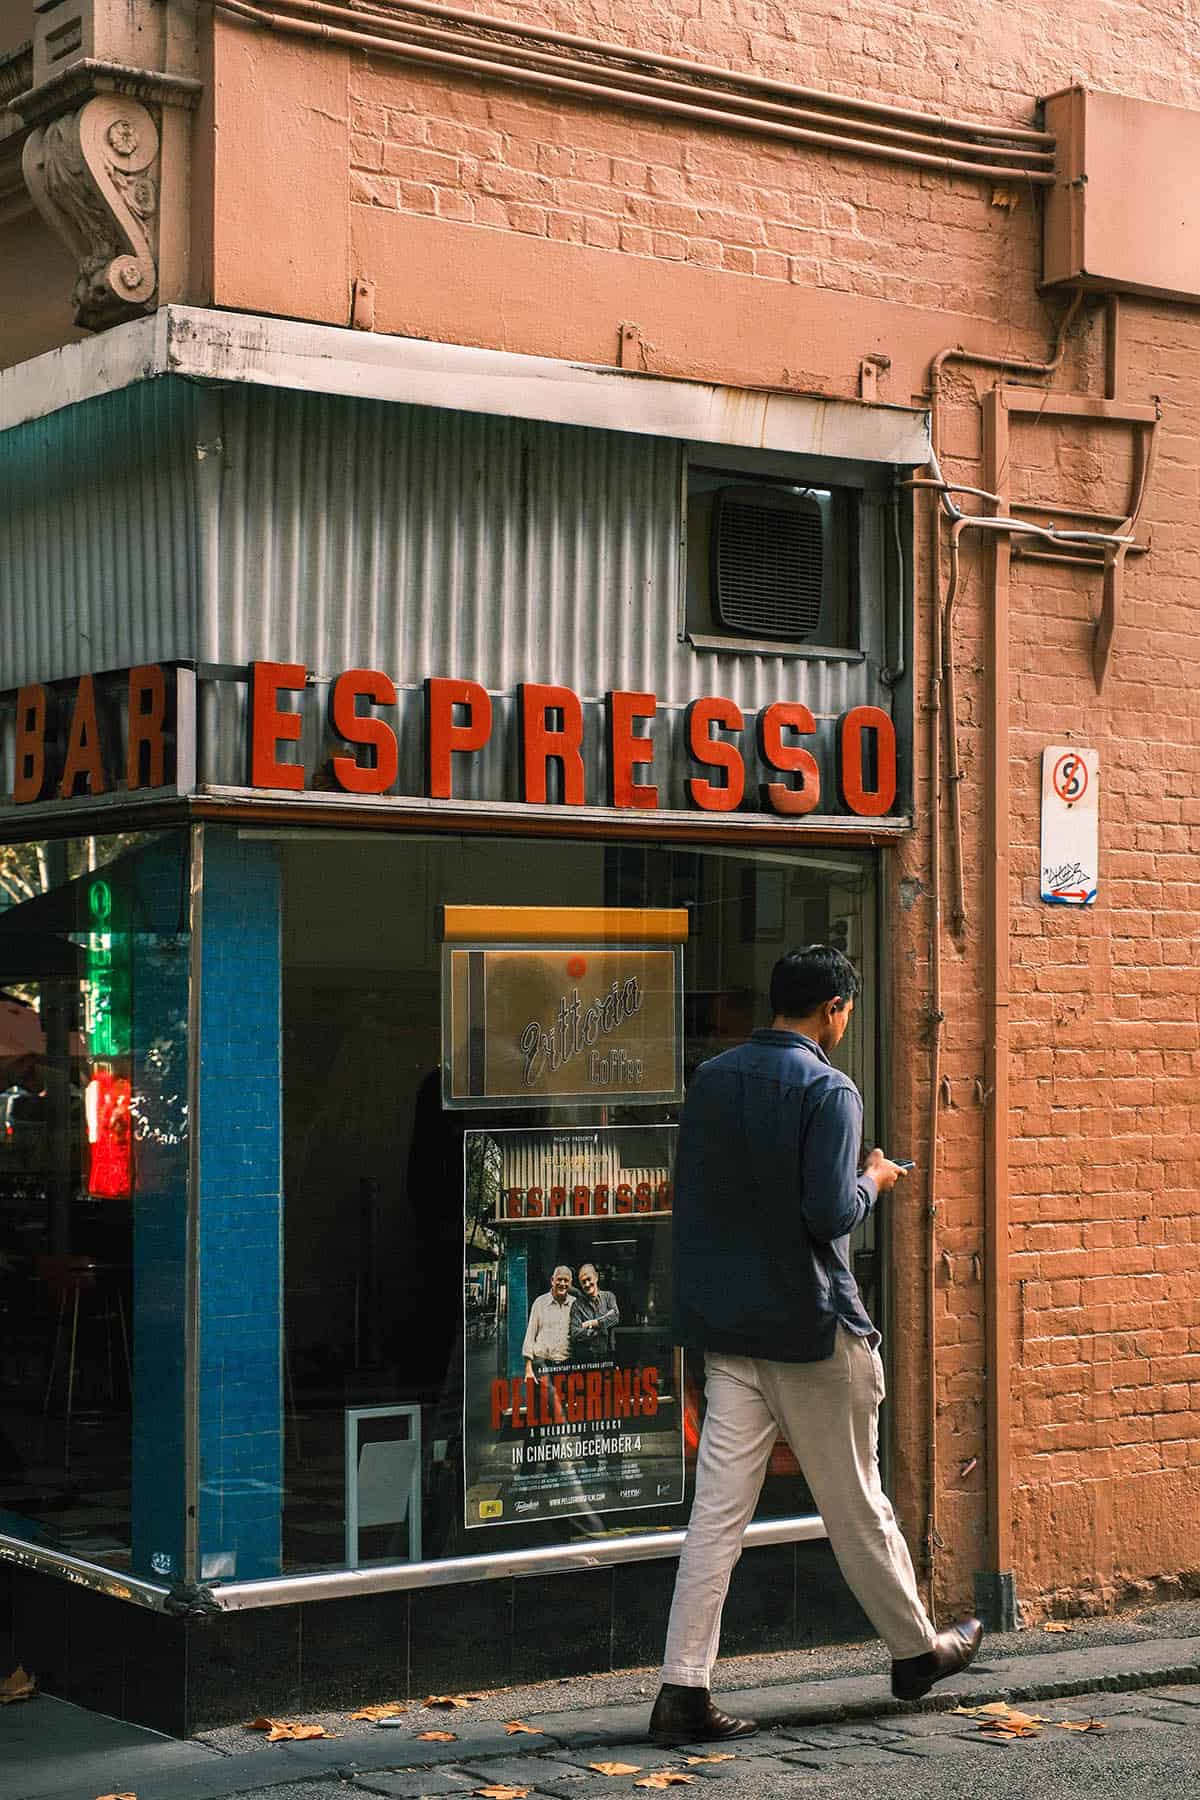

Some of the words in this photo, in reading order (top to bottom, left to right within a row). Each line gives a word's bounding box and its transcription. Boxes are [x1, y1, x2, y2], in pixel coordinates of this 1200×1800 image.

[13, 663, 166, 804] BAR
[249, 661, 897, 816] ESPRESSO
[590, 1048, 644, 1085] Coffee
[530, 1427, 535, 1437] A
[540, 1422, 587, 1437] MELBOURNE
[592, 1418, 622, 1434] LEGACY
[511, 1446, 524, 1465] IN
[526, 1440, 574, 1463] CINEMAS
[575, 1436, 632, 1458] DECEMBER
[634, 1434, 642, 1451] 4
